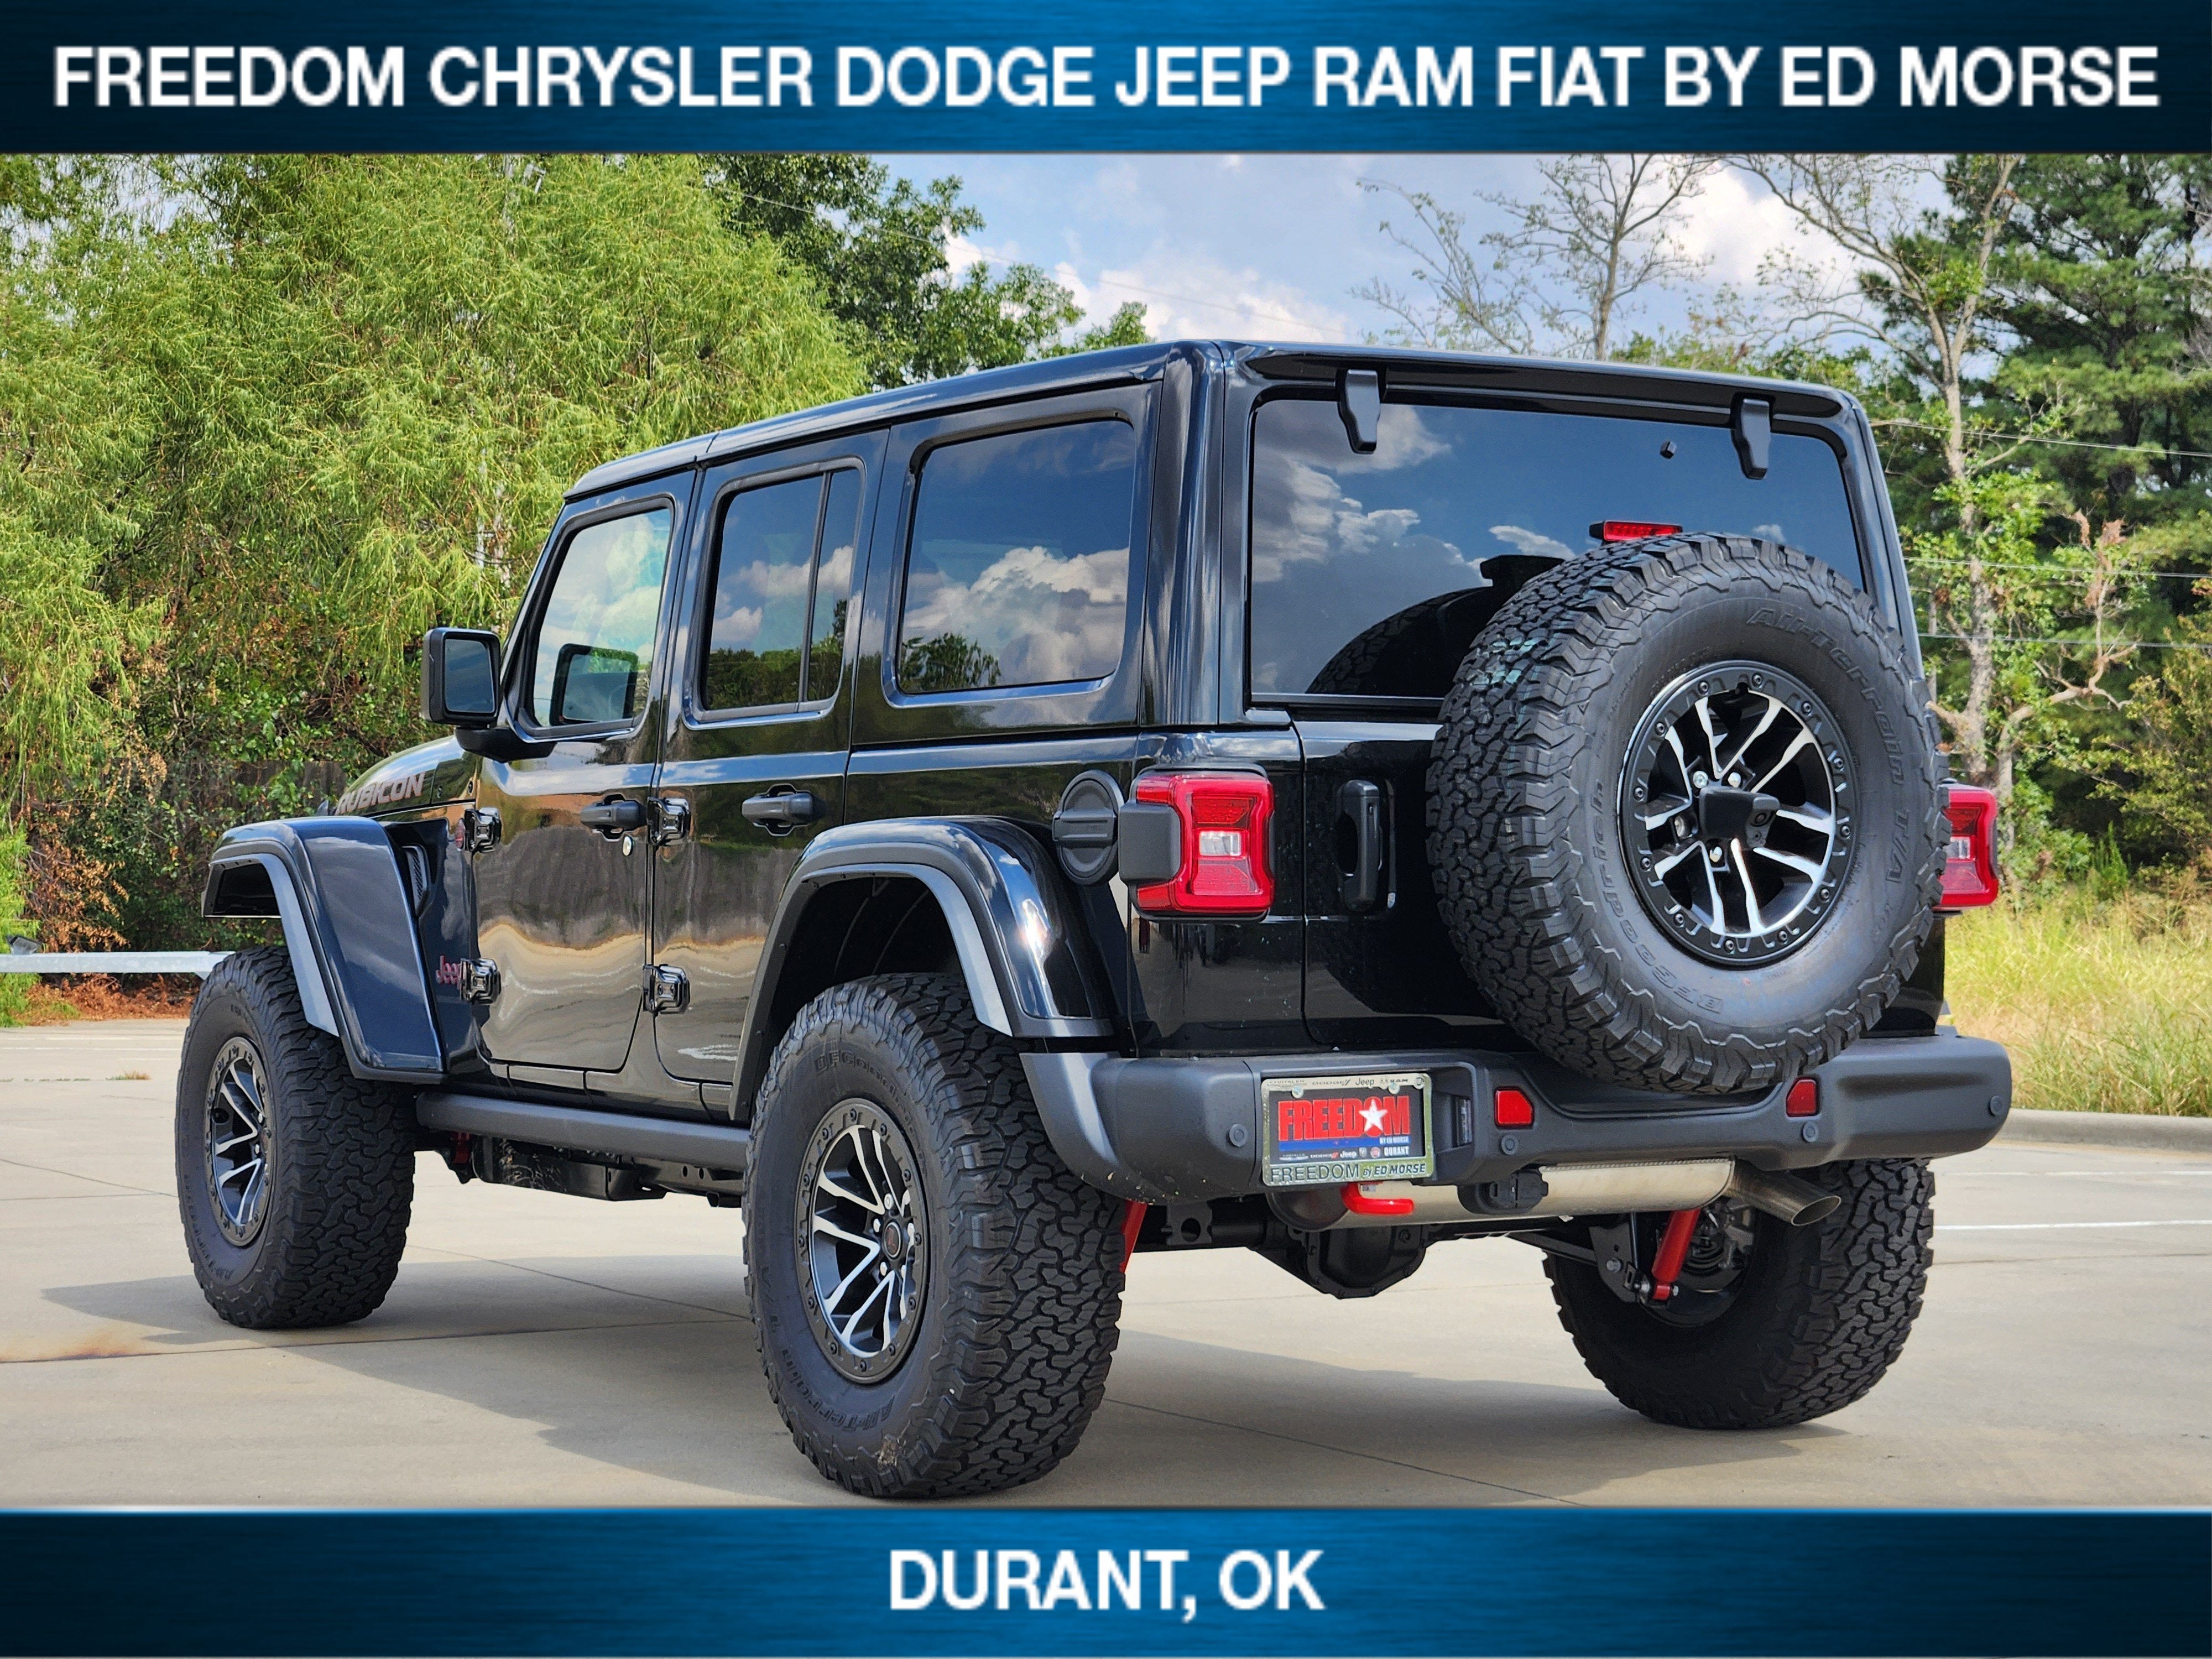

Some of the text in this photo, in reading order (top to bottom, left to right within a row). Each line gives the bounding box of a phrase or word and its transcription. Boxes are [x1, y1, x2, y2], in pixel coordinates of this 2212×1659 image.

[335, 772, 426, 816] RUBICON
[1355, 1077, 1375, 1087] Jeep
[1278, 1095, 1410, 1141] FREEDOM
[1340, 1150, 1357, 1159] Jeep
[1384, 1145, 1410, 1156] DURANT
[1271, 1163, 1359, 1182] FREEDOM
[1374, 1165, 1387, 1175] ED
[1389, 1163, 1426, 1175] MORSE
